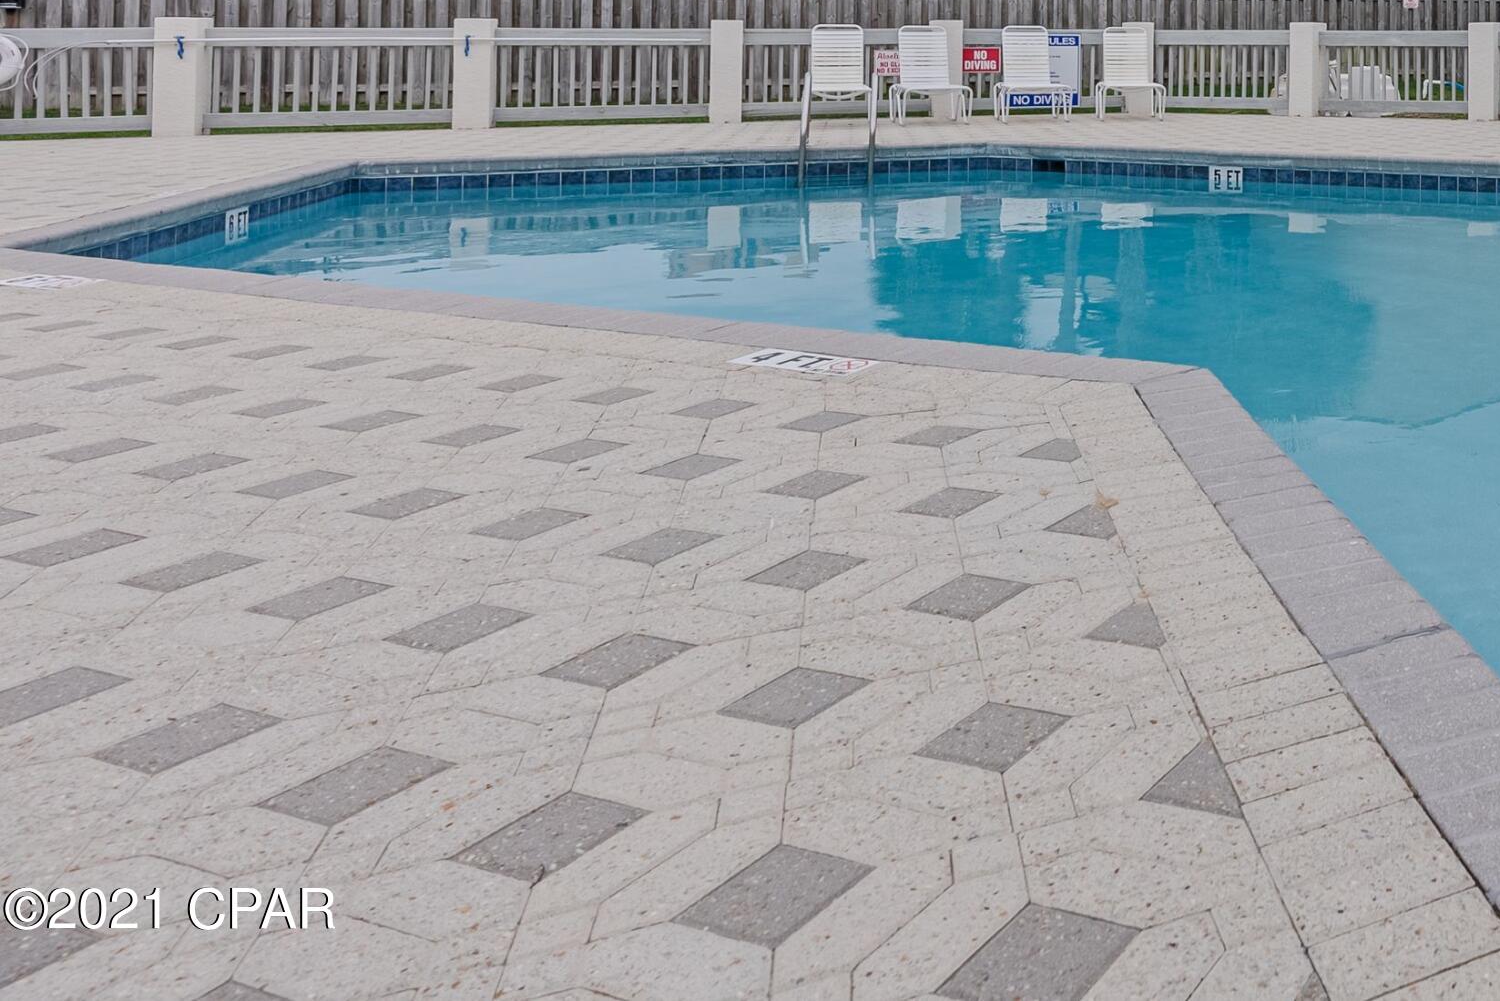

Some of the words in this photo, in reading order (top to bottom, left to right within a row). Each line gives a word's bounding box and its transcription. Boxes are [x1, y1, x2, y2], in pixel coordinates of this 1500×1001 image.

[1048, 37, 1076, 46] ULES
[973, 50, 987, 60] NO
[964, 61, 997, 70] DIVING
[1013, 95, 1030, 105] NO
